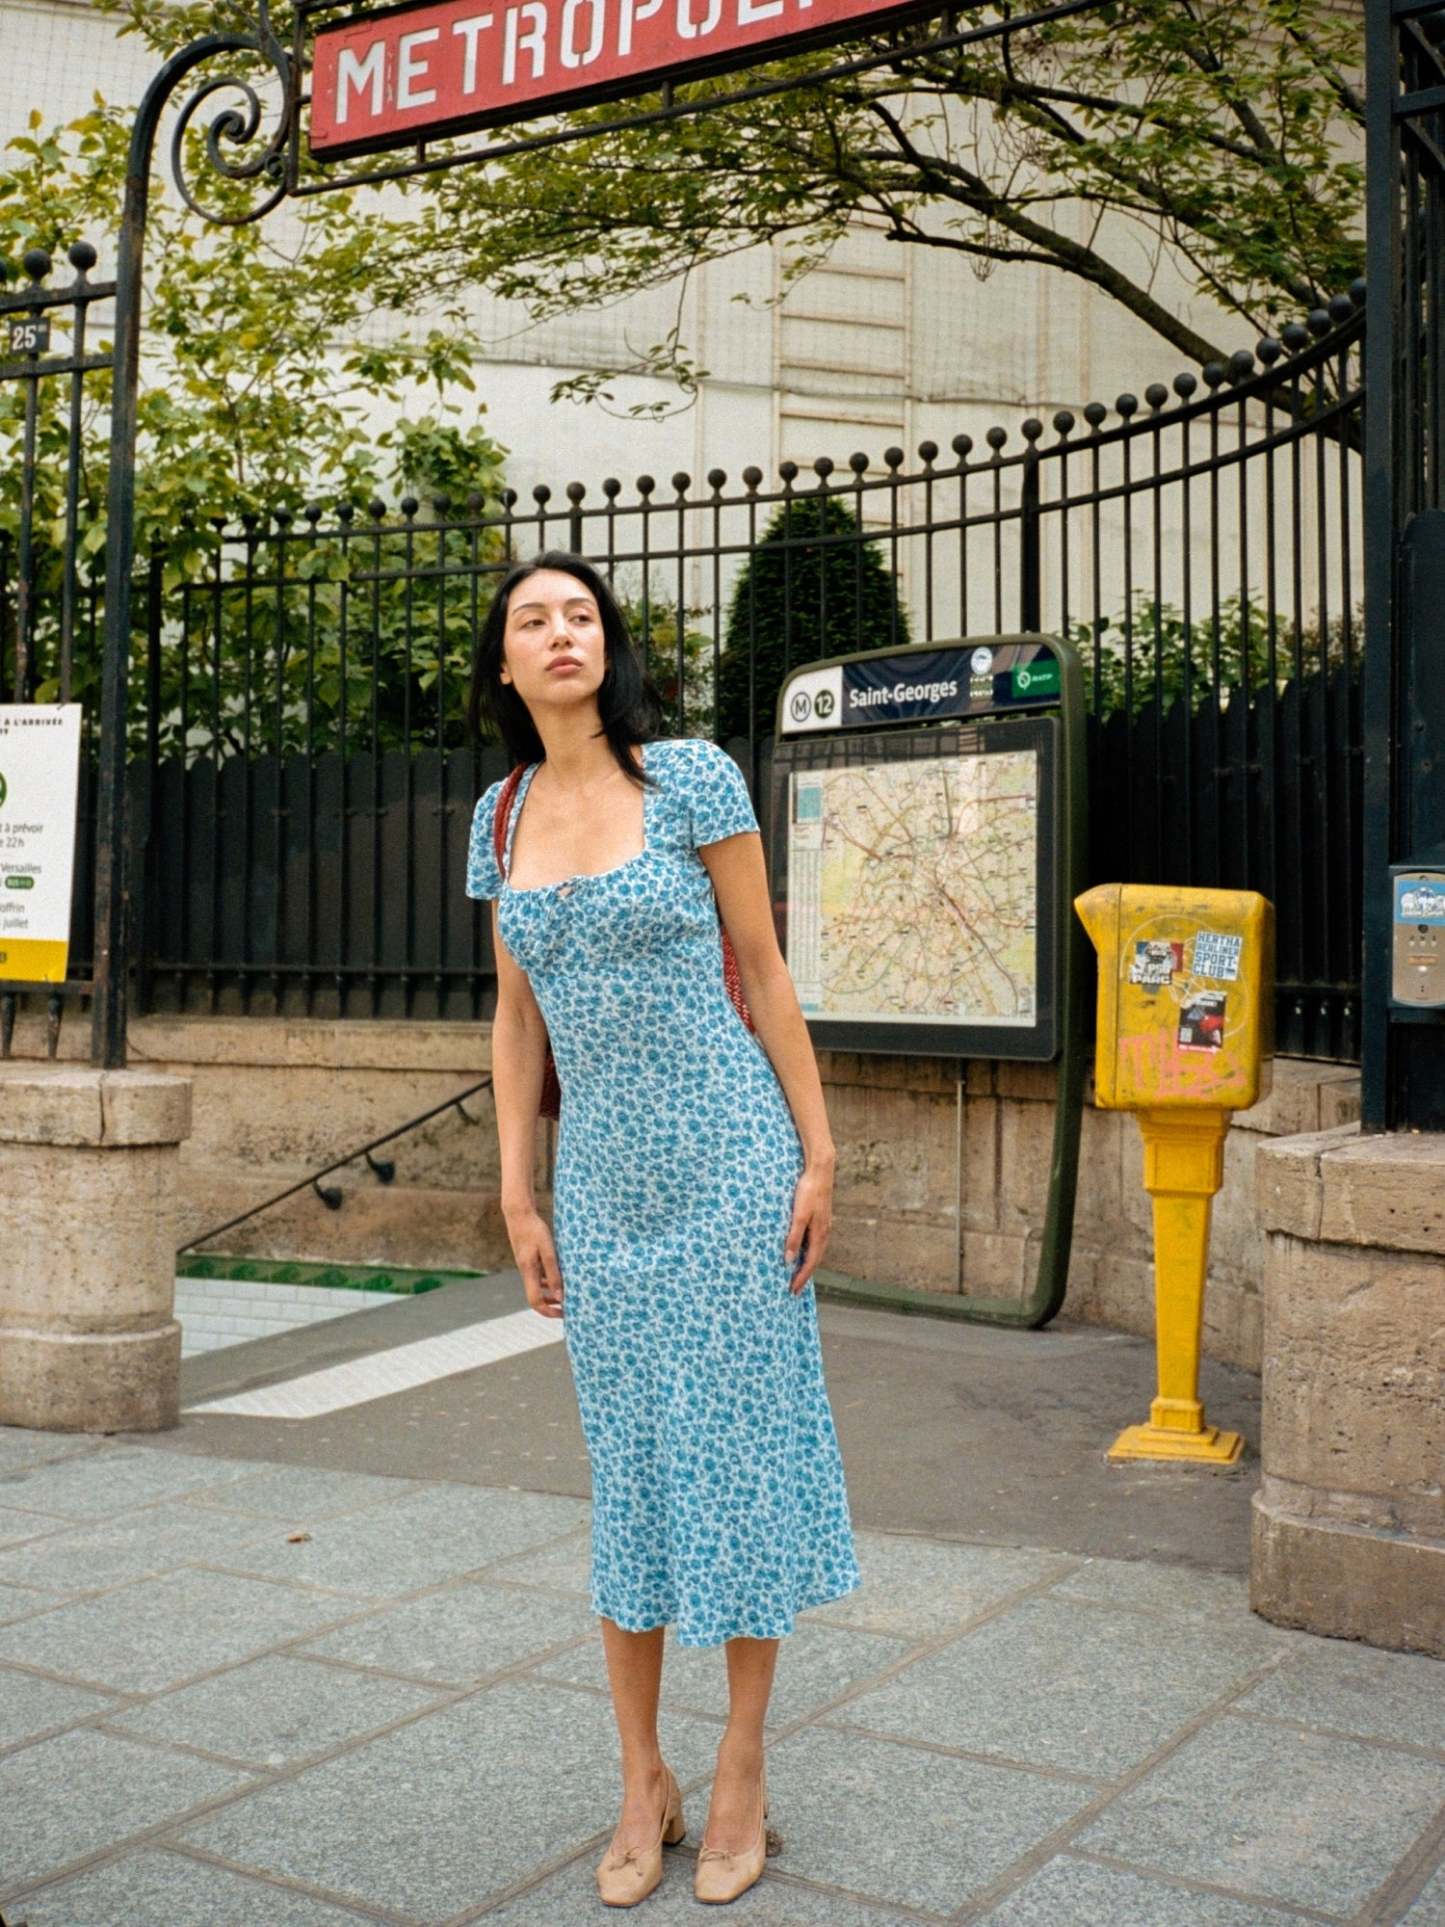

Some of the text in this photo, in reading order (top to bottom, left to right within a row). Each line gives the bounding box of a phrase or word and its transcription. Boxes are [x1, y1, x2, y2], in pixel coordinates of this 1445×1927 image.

[13, 325, 37, 350] 25
[816, 695, 833, 715] 12
[849, 681, 957, 708] Saint-Georges
[12, 823, 44, 835] prévoir
[1, 862, 42, 874] Versailles
[1198, 932, 1240, 947] HERTHA
[1193, 963, 1225, 978] CLUB
